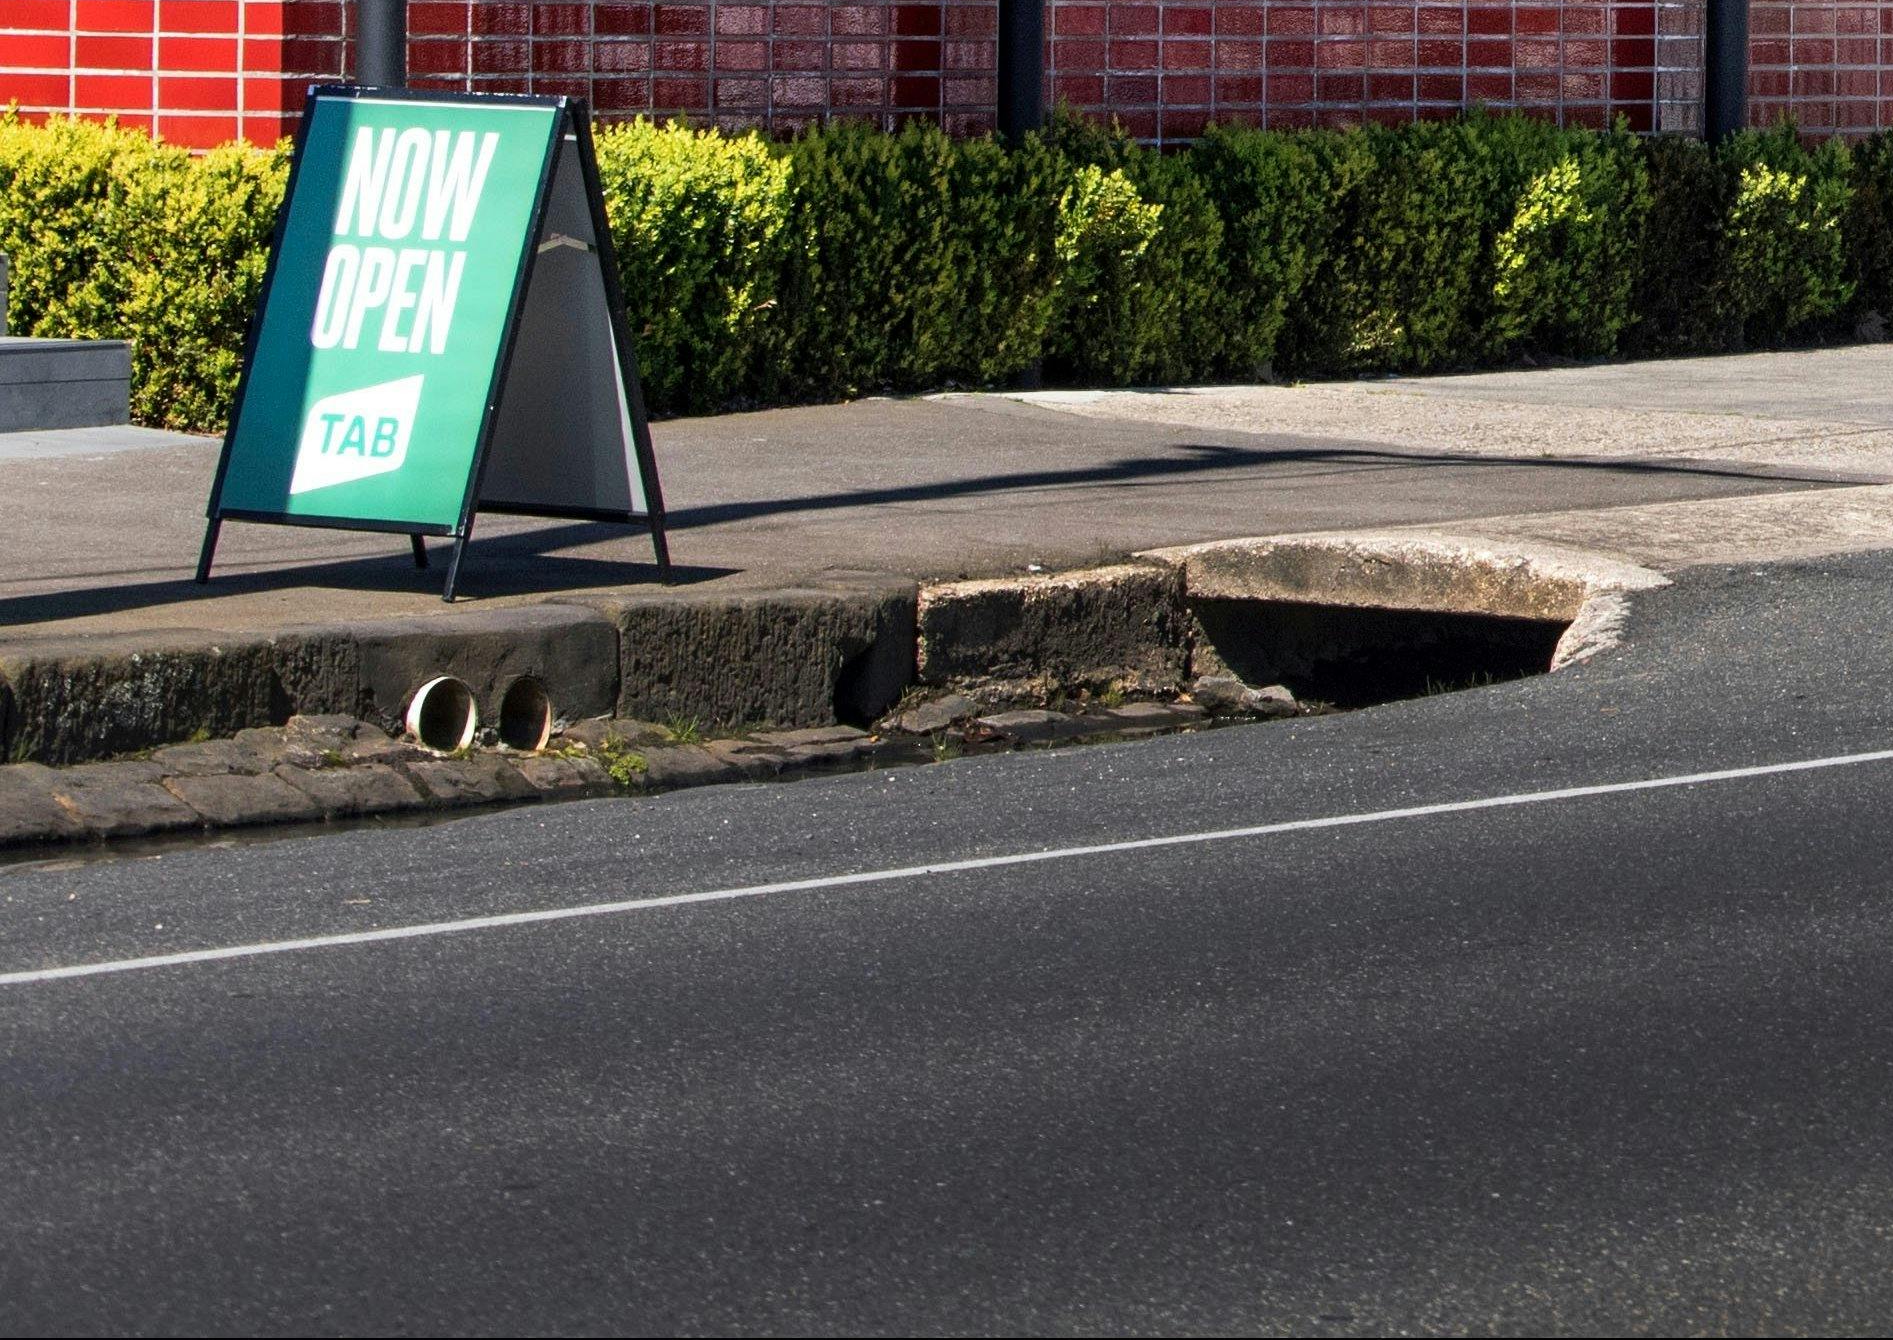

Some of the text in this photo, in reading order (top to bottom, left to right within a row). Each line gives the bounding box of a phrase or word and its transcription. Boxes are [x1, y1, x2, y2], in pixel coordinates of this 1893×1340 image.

[334, 125, 500, 242] NOW
[310, 243, 467, 355] OPEN
[319, 413, 400, 458] TAB
